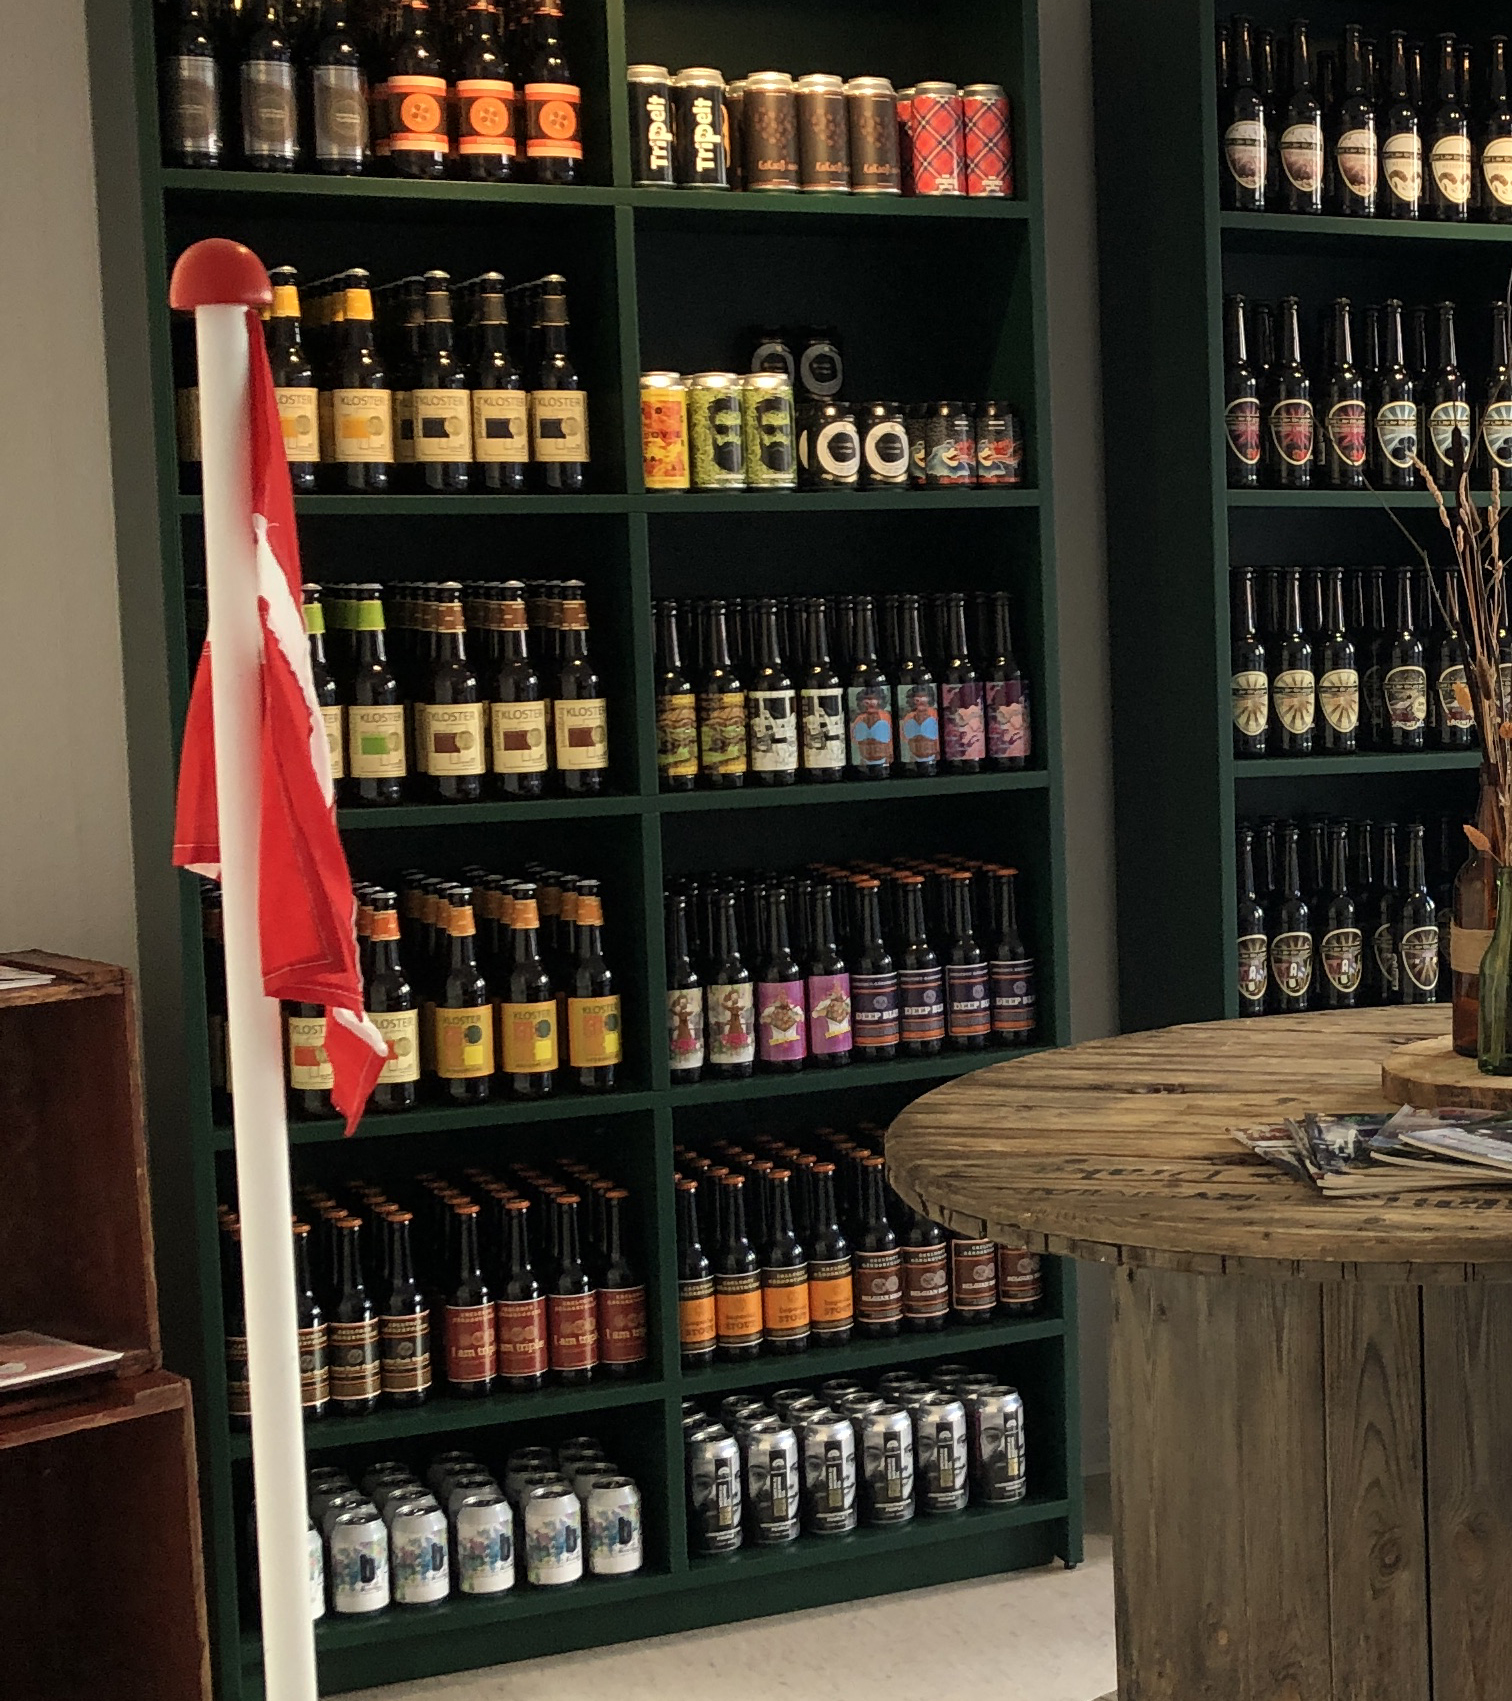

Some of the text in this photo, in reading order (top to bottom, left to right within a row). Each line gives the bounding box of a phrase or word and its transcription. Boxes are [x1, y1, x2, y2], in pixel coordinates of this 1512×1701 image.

[646, 95, 673, 169] Tripelt
[692, 97, 721, 172] Tripelt
[537, 396, 581, 407] KLOSTER
[429, 711, 475, 722] KLOSTER
[953, 1001, 979, 1011] DEEP
[995, 996, 1021, 1006] DEEP
[855, 1012, 881, 1021] DEEP
[904, 1006, 930, 1016] DEEP
[376, 1017, 412, 1029] LOSTER
[293, 1024, 325, 1035] KLOST
